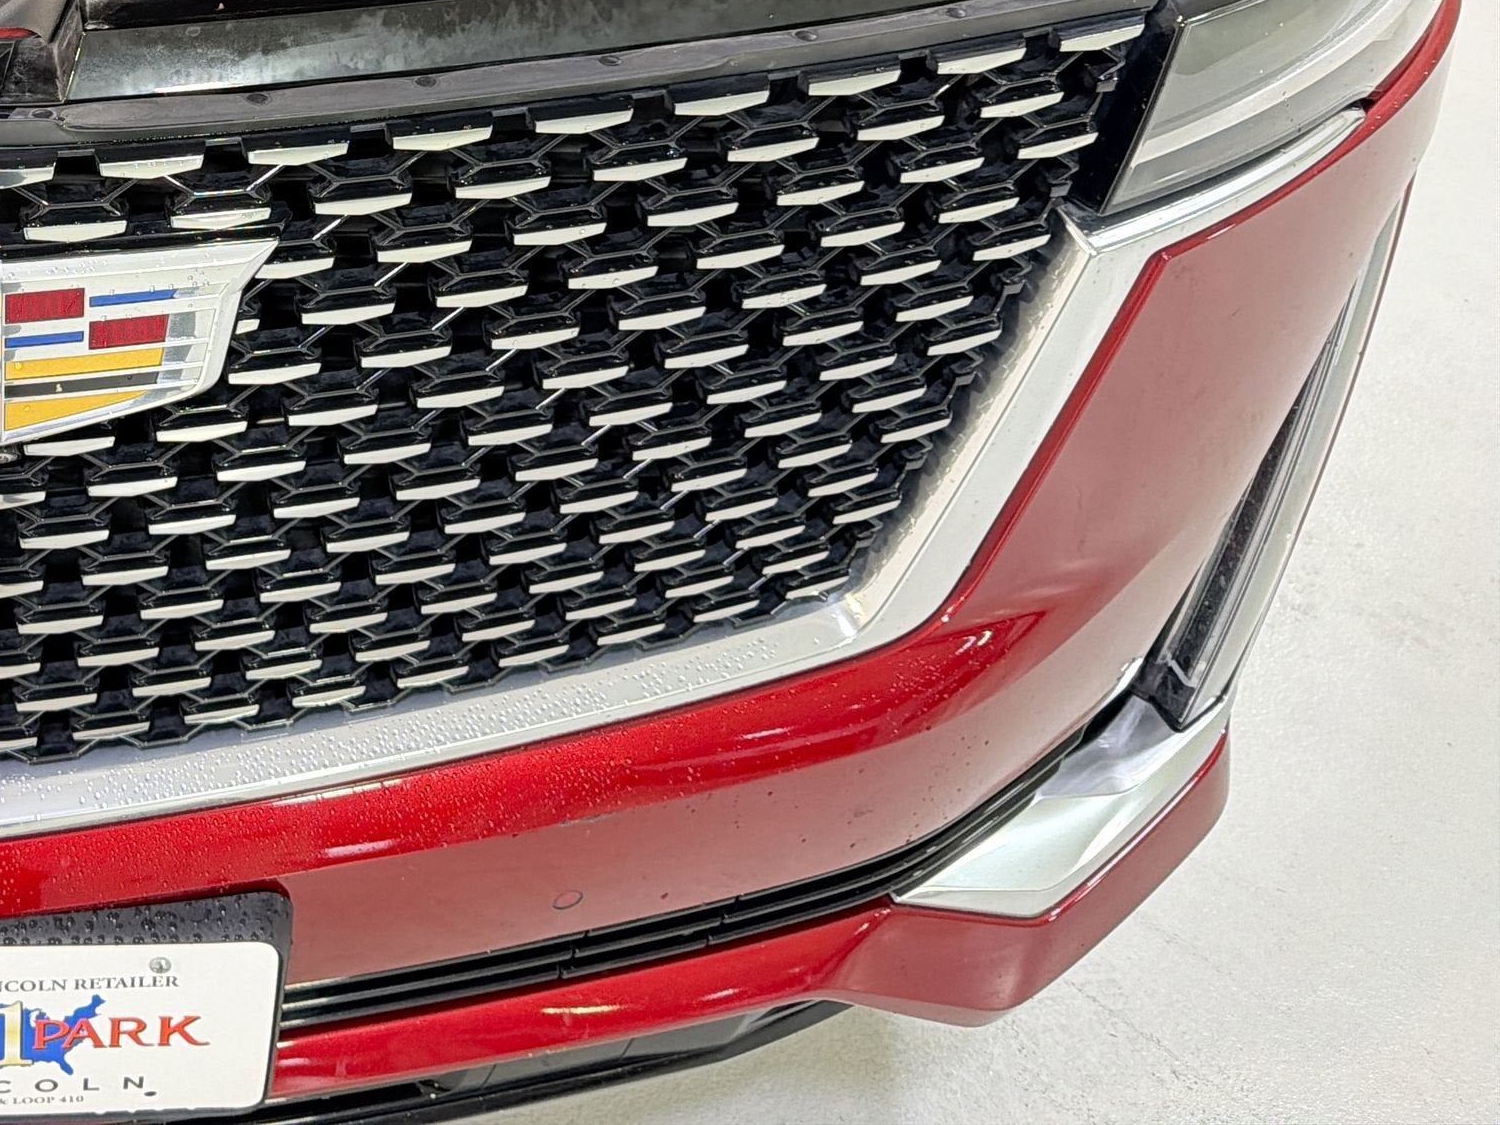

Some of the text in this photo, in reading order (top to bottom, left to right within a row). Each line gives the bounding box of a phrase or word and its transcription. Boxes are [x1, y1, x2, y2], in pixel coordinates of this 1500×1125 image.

[73, 975, 180, 991] RETAILER
[32, 1015, 211, 1051] PARK
[12, 1096, 56, 1106] LOOP
[59, 1095, 85, 1104] 410
